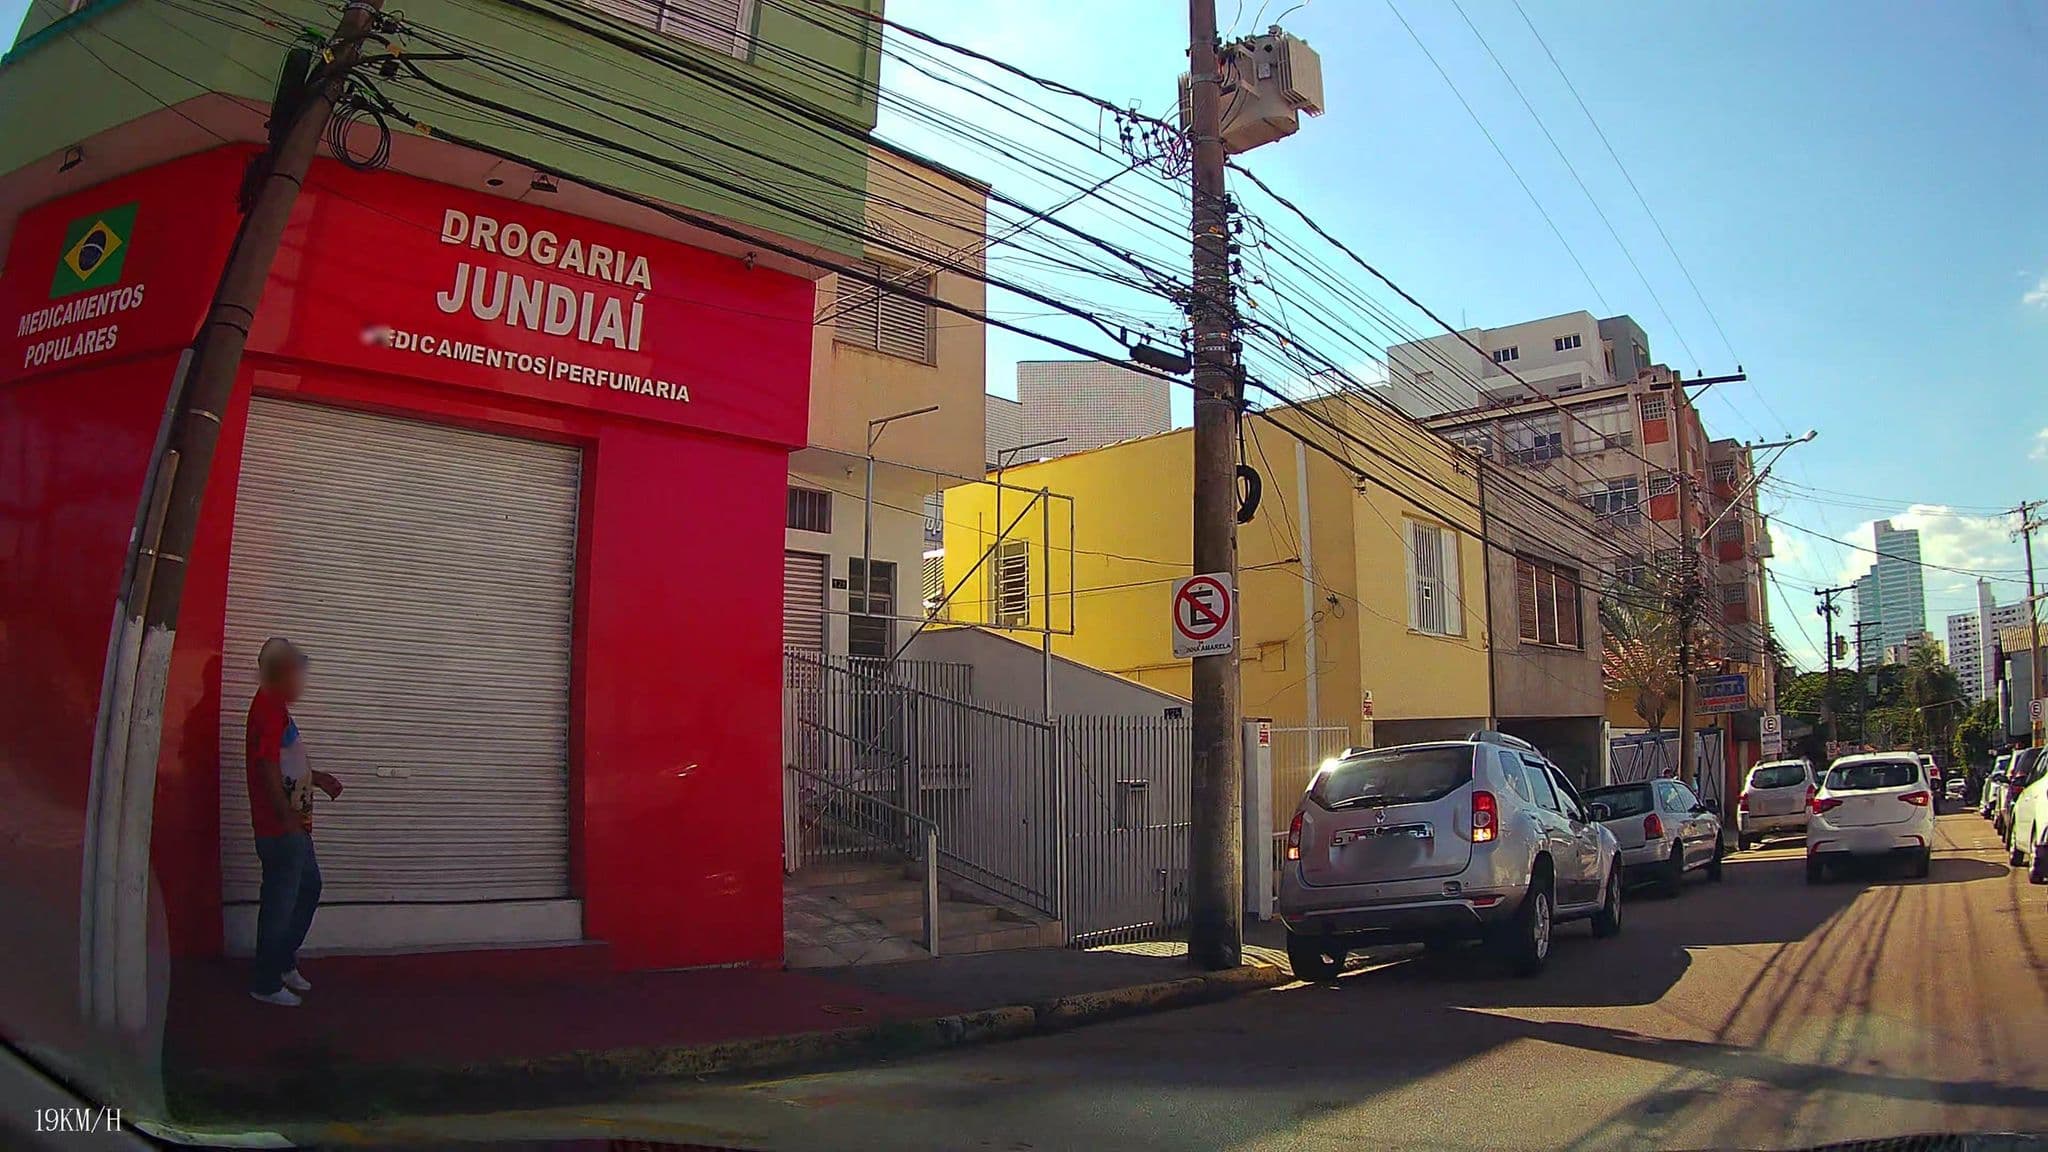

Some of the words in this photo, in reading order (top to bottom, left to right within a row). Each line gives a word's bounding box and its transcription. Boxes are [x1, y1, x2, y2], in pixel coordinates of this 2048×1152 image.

[441, 208, 652, 290] DROGARIA
[17, 283, 145, 338] MEDICAMENTOS
[436, 262, 645, 351] JUNDIAÍ
[24, 324, 119, 369] POPULARES
[1190, 589, 1213, 626] E
